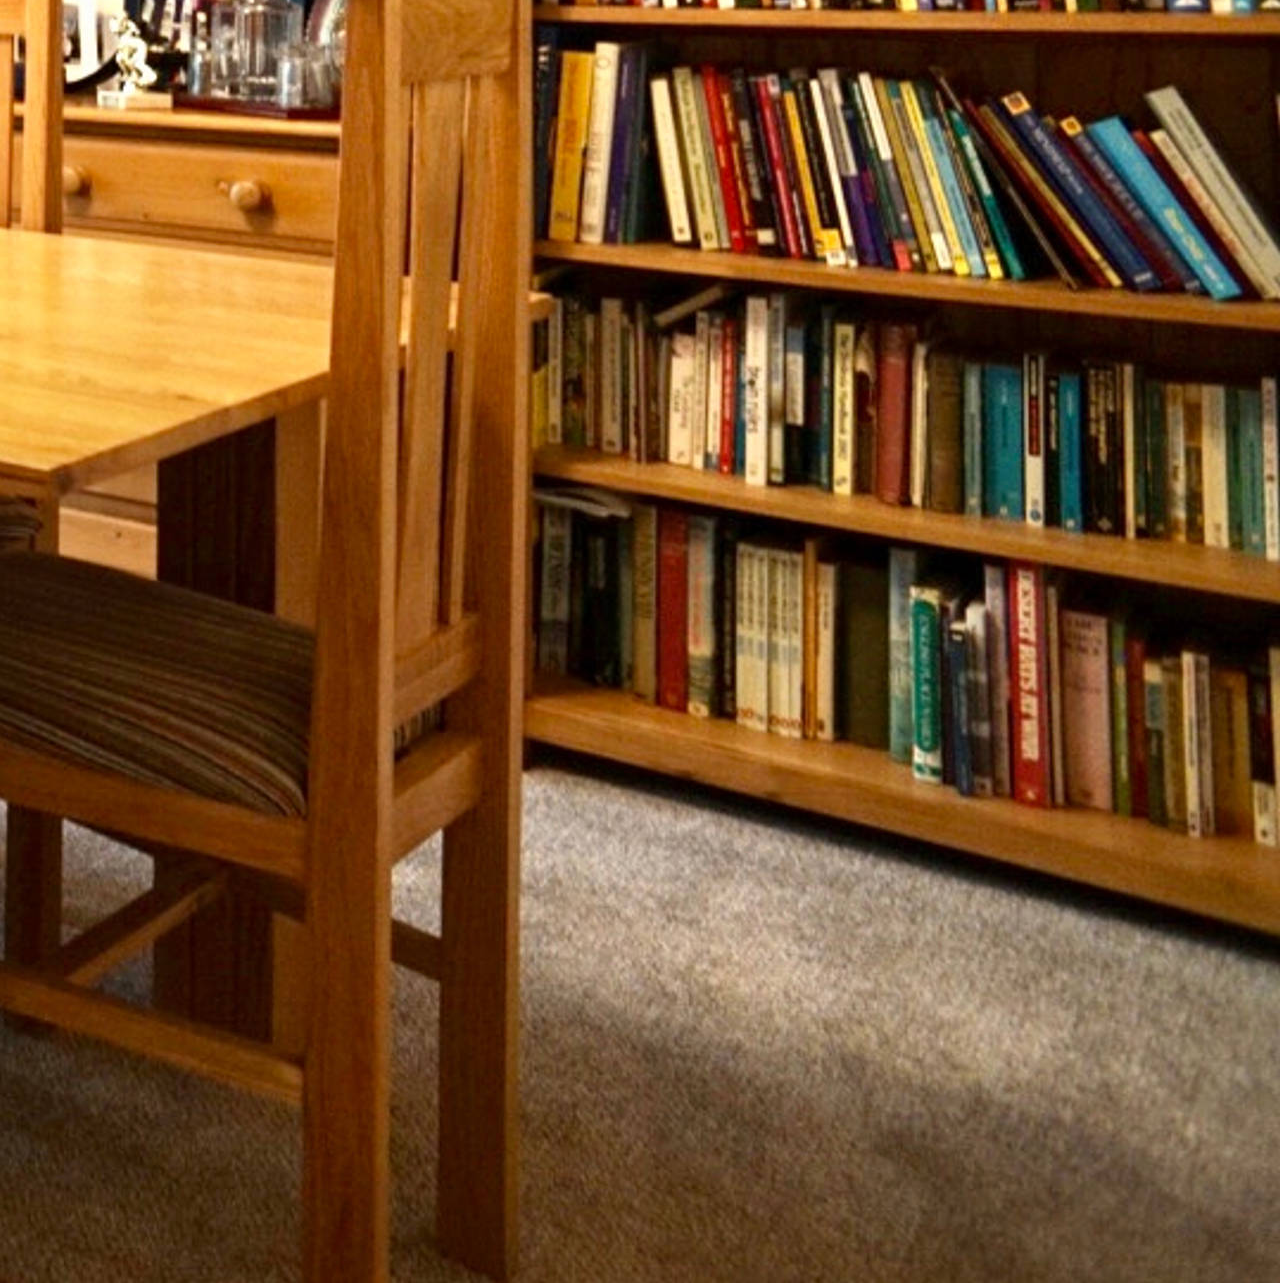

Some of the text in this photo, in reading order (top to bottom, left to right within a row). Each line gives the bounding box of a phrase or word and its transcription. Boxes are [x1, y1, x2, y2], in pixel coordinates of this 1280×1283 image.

[1017, 569, 1040, 762] DESERT RATS AT WAR
